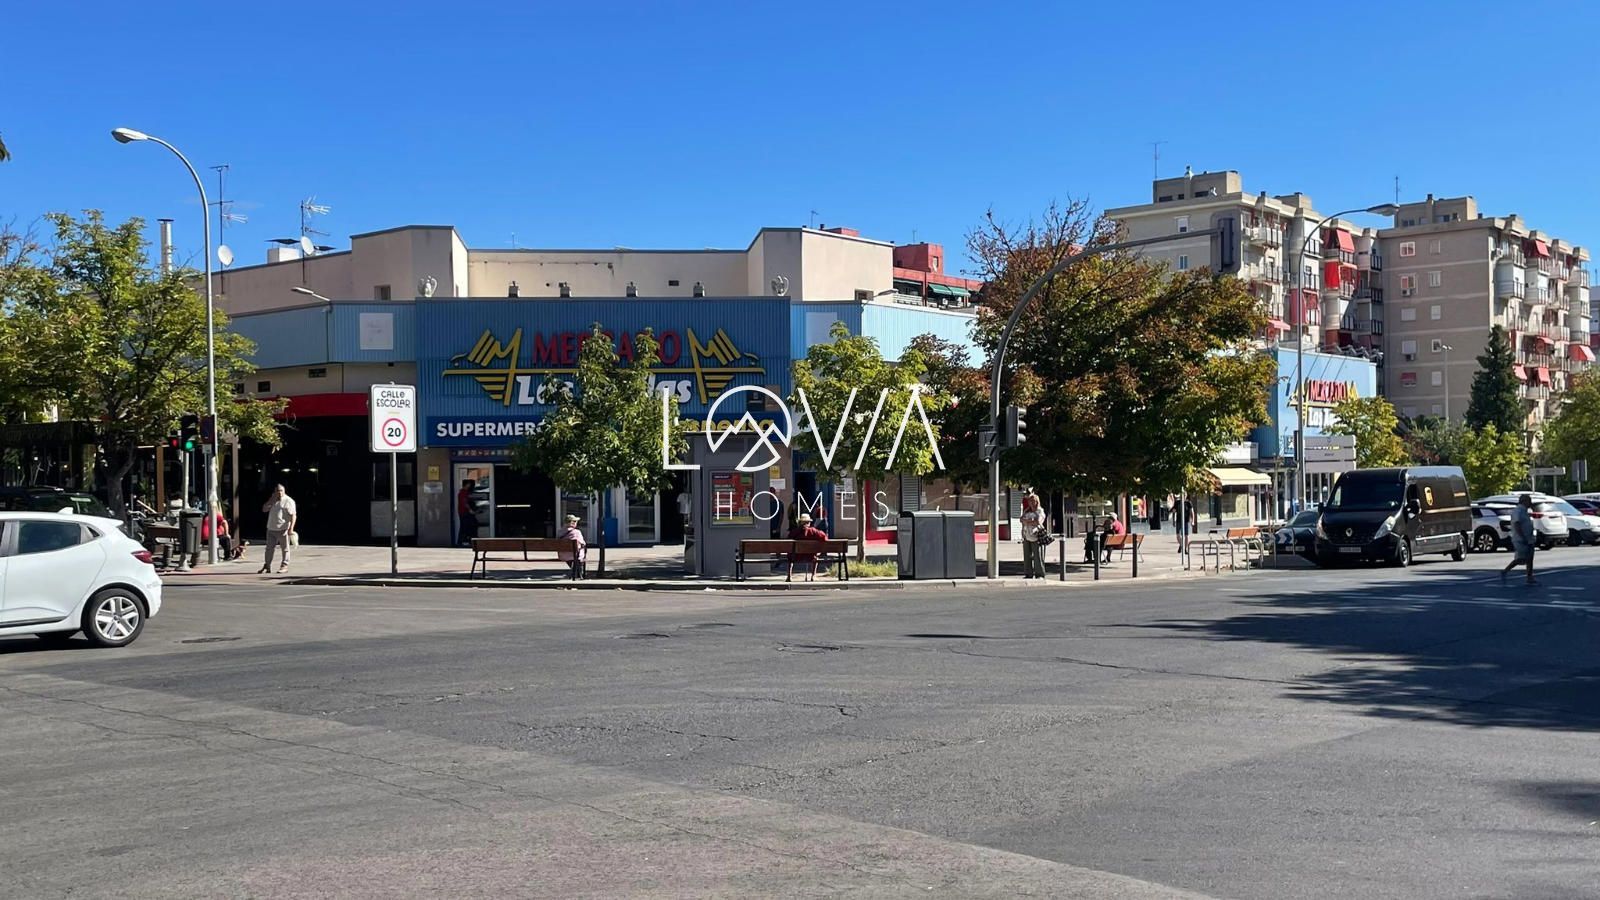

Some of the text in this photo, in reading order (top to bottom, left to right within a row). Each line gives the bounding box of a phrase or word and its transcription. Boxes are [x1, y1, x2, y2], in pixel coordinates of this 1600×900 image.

[532, 330, 682, 365] MEAO
[376, 398, 411, 409] ESCOLAR
[387, 427, 402, 437] 20
